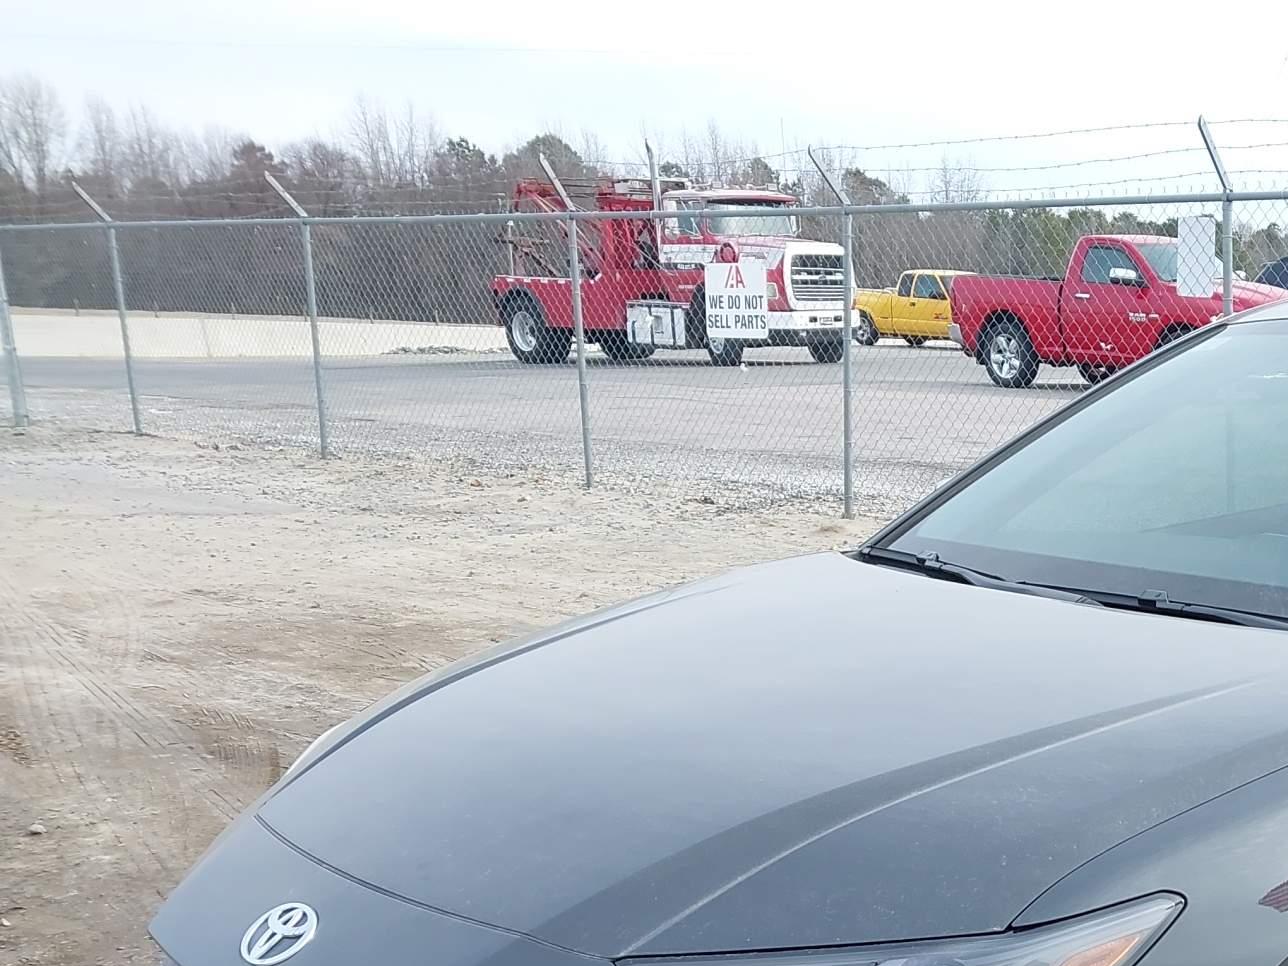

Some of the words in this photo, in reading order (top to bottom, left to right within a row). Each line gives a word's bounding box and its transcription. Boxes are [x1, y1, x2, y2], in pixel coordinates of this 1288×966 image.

[709, 295, 724, 310] WE
[728, 295, 741, 310] DO
[744, 295, 764, 310] NOT
[708, 314, 731, 329] SELL
[734, 314, 767, 330] PARTS
